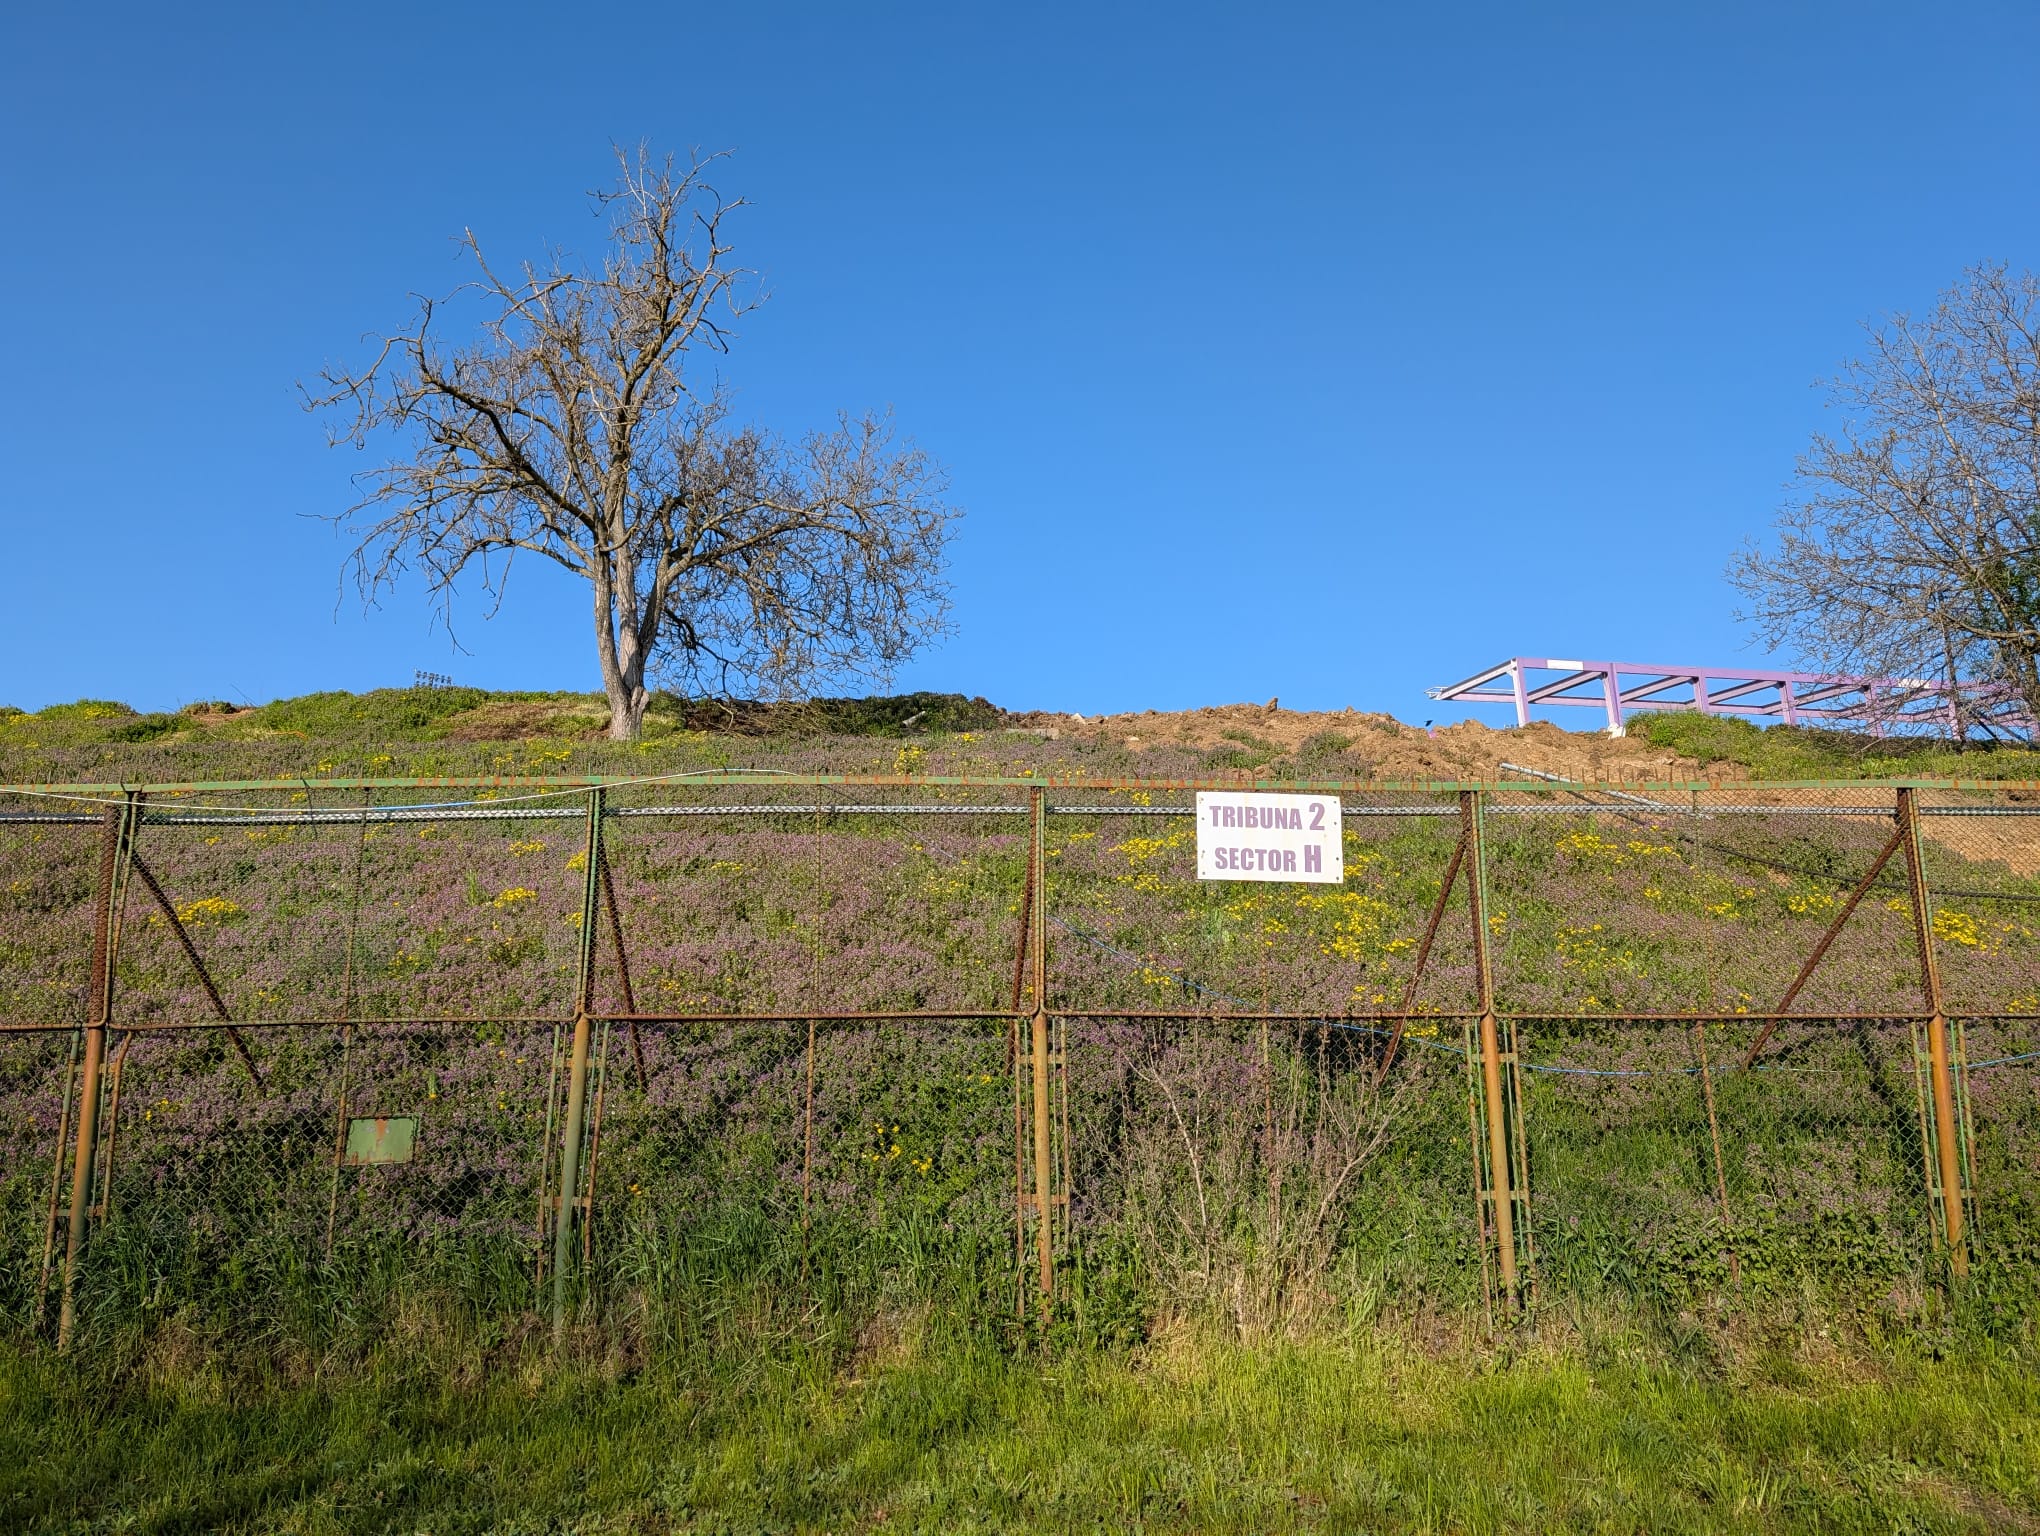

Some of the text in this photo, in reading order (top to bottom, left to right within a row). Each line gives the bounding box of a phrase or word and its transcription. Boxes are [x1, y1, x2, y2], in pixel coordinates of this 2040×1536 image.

[1209, 802, 1325, 831] TRIBUNA 2
[1214, 844, 1322, 873] SECTOR H
